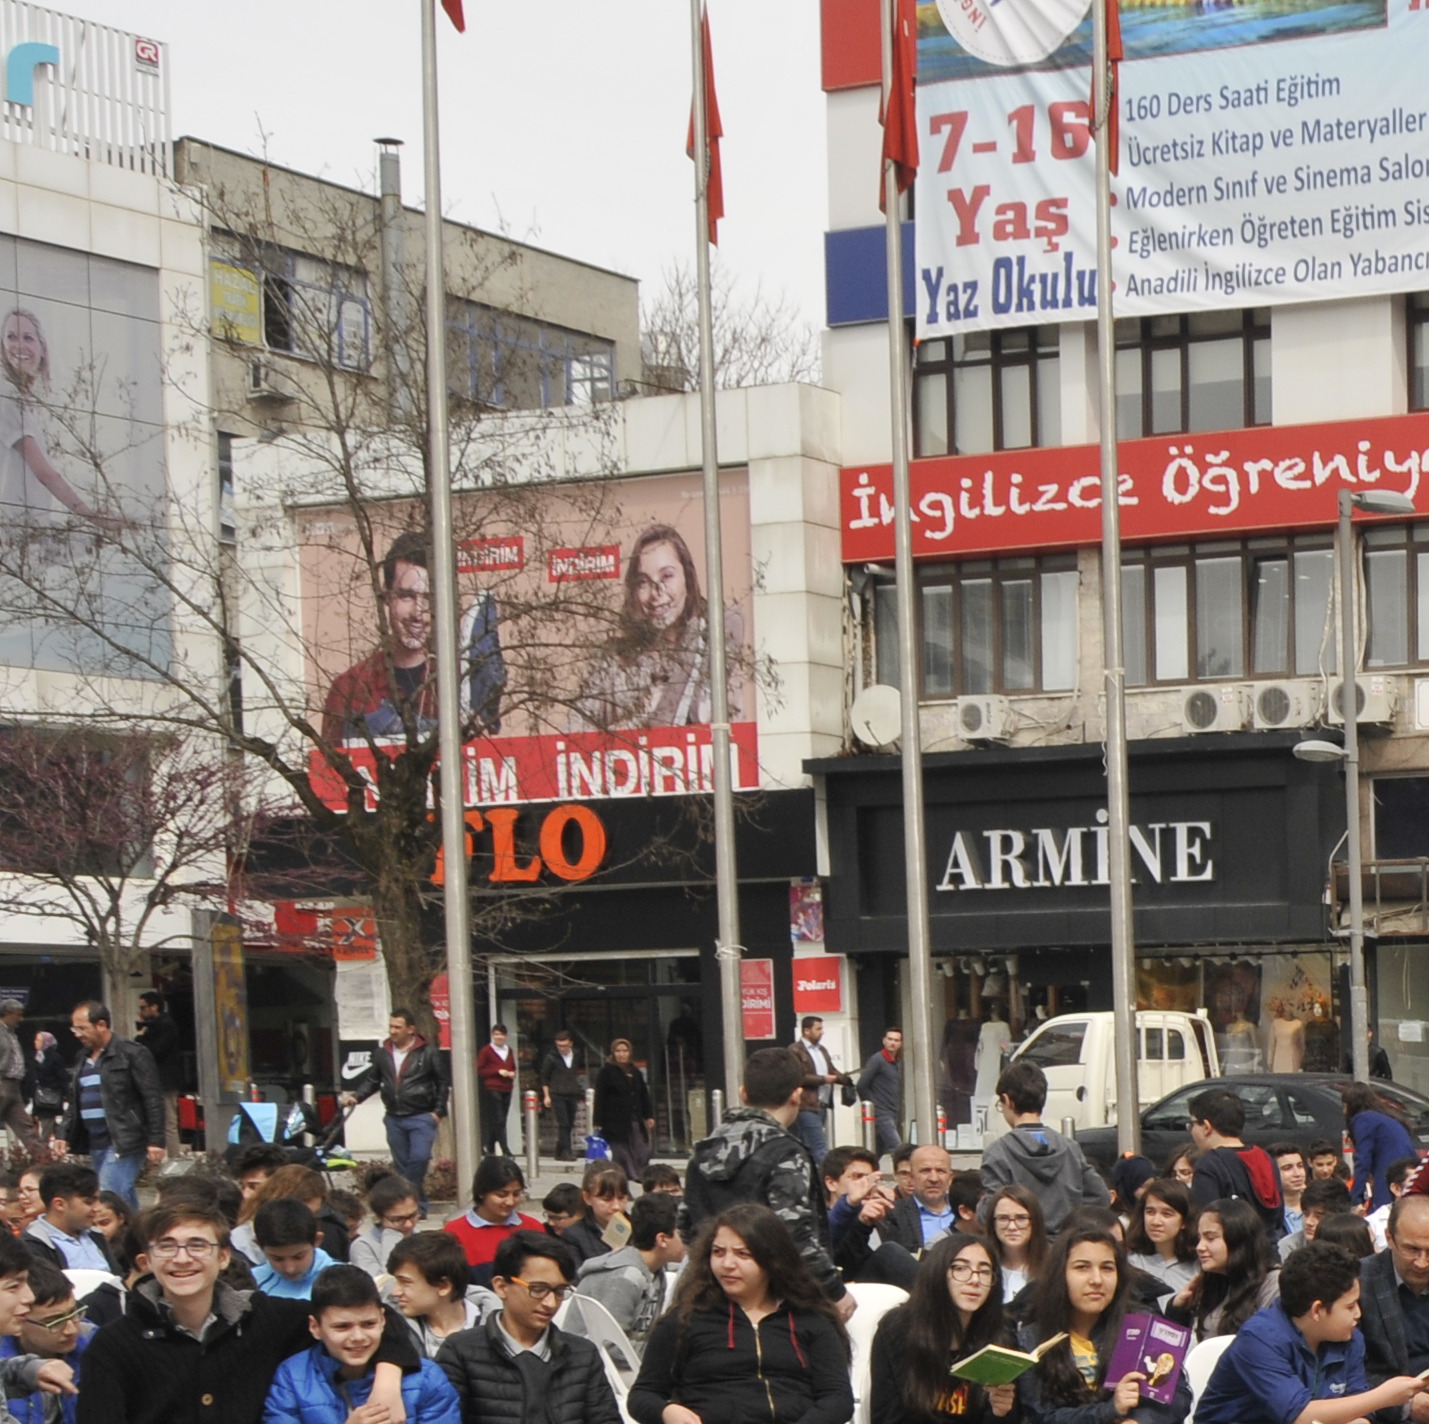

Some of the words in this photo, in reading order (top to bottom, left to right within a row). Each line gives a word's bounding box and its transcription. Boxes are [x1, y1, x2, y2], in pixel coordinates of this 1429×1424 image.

[1125, 94, 1161, 122] 160
[1167, 92, 1212, 117] Ders
[1218, 79, 1269, 110] Saati
[1275, 72, 1341, 107] Eğitim
[929, 100, 1090, 174] 7-16
[1128, 133, 1205, 167] Ücretsiz
[1211, 128, 1264, 157] Kitap
[1270, 127, 1293, 148] ve
[1301, 107, 1427, 145] Materyaller
[1126, 182, 1208, 210] Modern
[1213, 170, 1259, 201] Sınıf
[1263, 172, 1288, 195] ve
[1294, 164, 1372, 192] Sinema
[946, 184, 1069, 254] Yaş
[1128, 223, 1234, 260] Eğlenirken
[1240, 212, 1324, 249] Öğreten
[1330, 204, 1397, 239] Eğitim
[921, 265, 979, 325] Yaz
[991, 250, 1098, 315] Okulu
[1125, 268, 1198, 297] Anadili
[1203, 260, 1287, 297] İngilizce
[1293, 255, 1343, 283] Olan
[849, 469, 1140, 541] İngilizce
[556, 732, 739, 798] İNDİRİM
[936, 808, 1214, 891] ARMİNE
[742, 987, 756, 996] YÜK
[797, 978, 837, 992] Polaris
